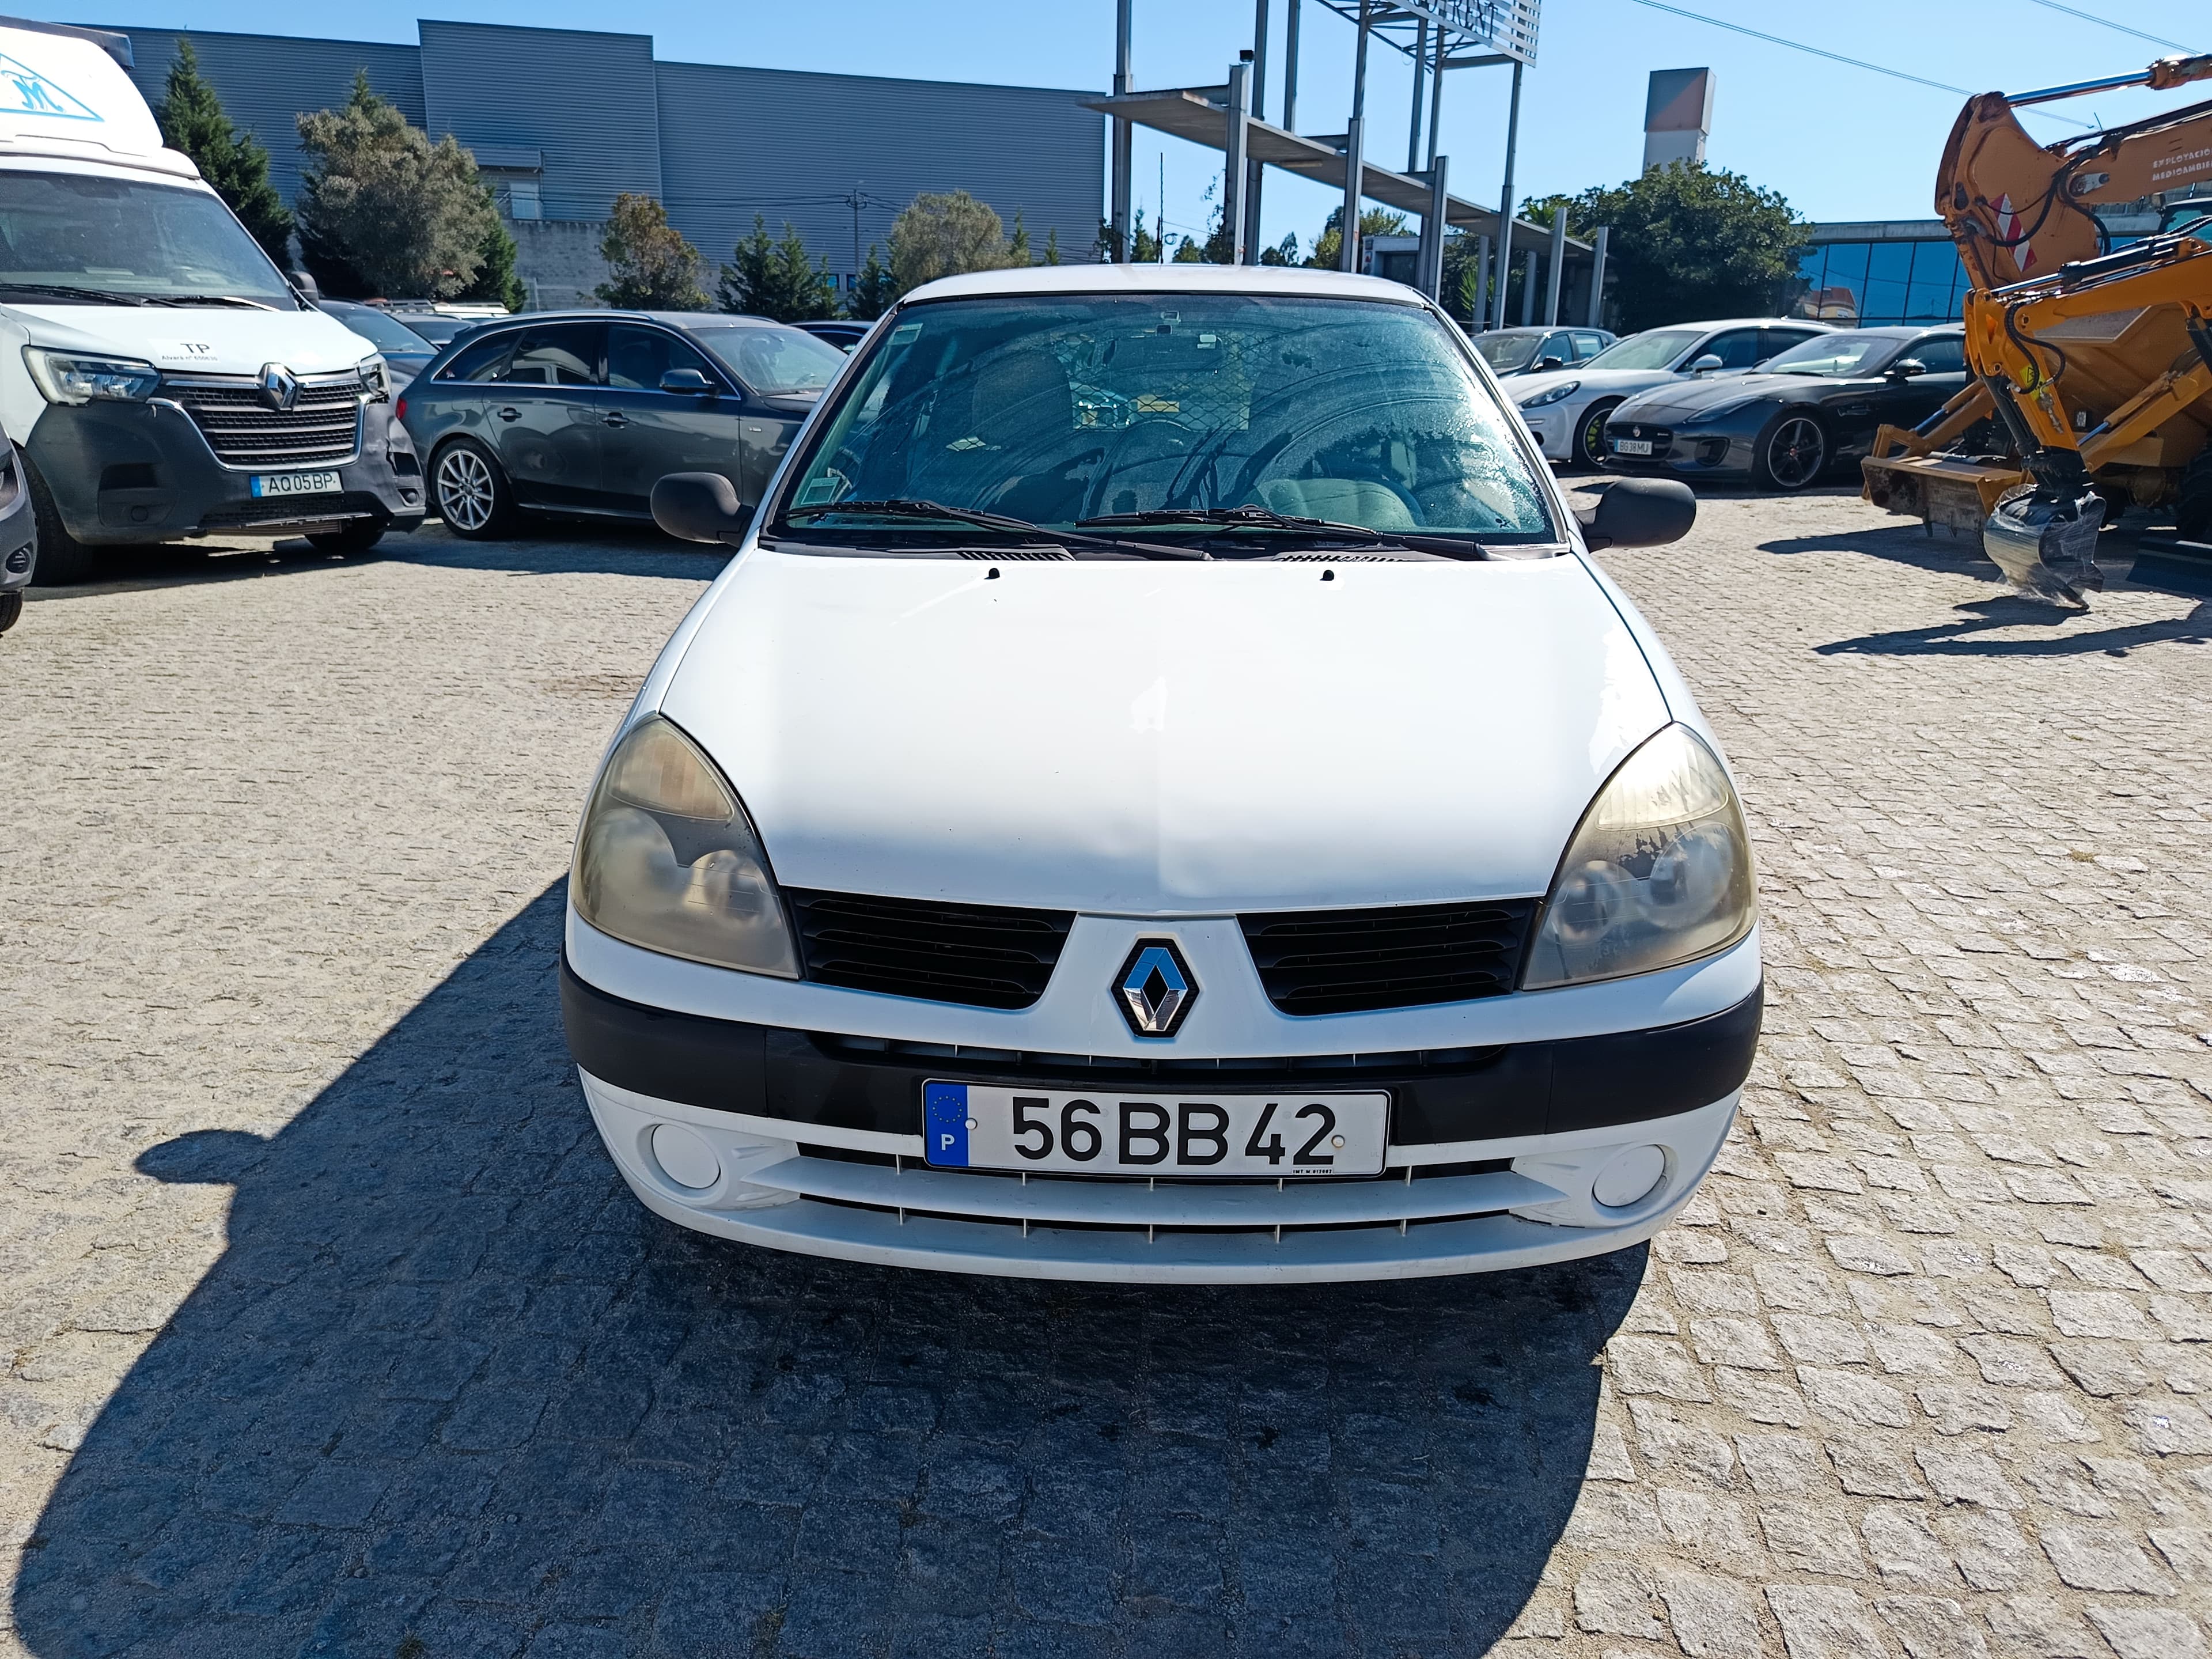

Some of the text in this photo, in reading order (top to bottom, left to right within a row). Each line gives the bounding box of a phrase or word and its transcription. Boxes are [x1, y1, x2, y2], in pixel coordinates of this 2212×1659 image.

[2153, 148, 2212, 168] EXPLOTACIO
[2153, 161, 2212, 181] MEDIOAMBIE
[180, 343, 210, 353] TP
[941, 1134, 955, 1150] P
